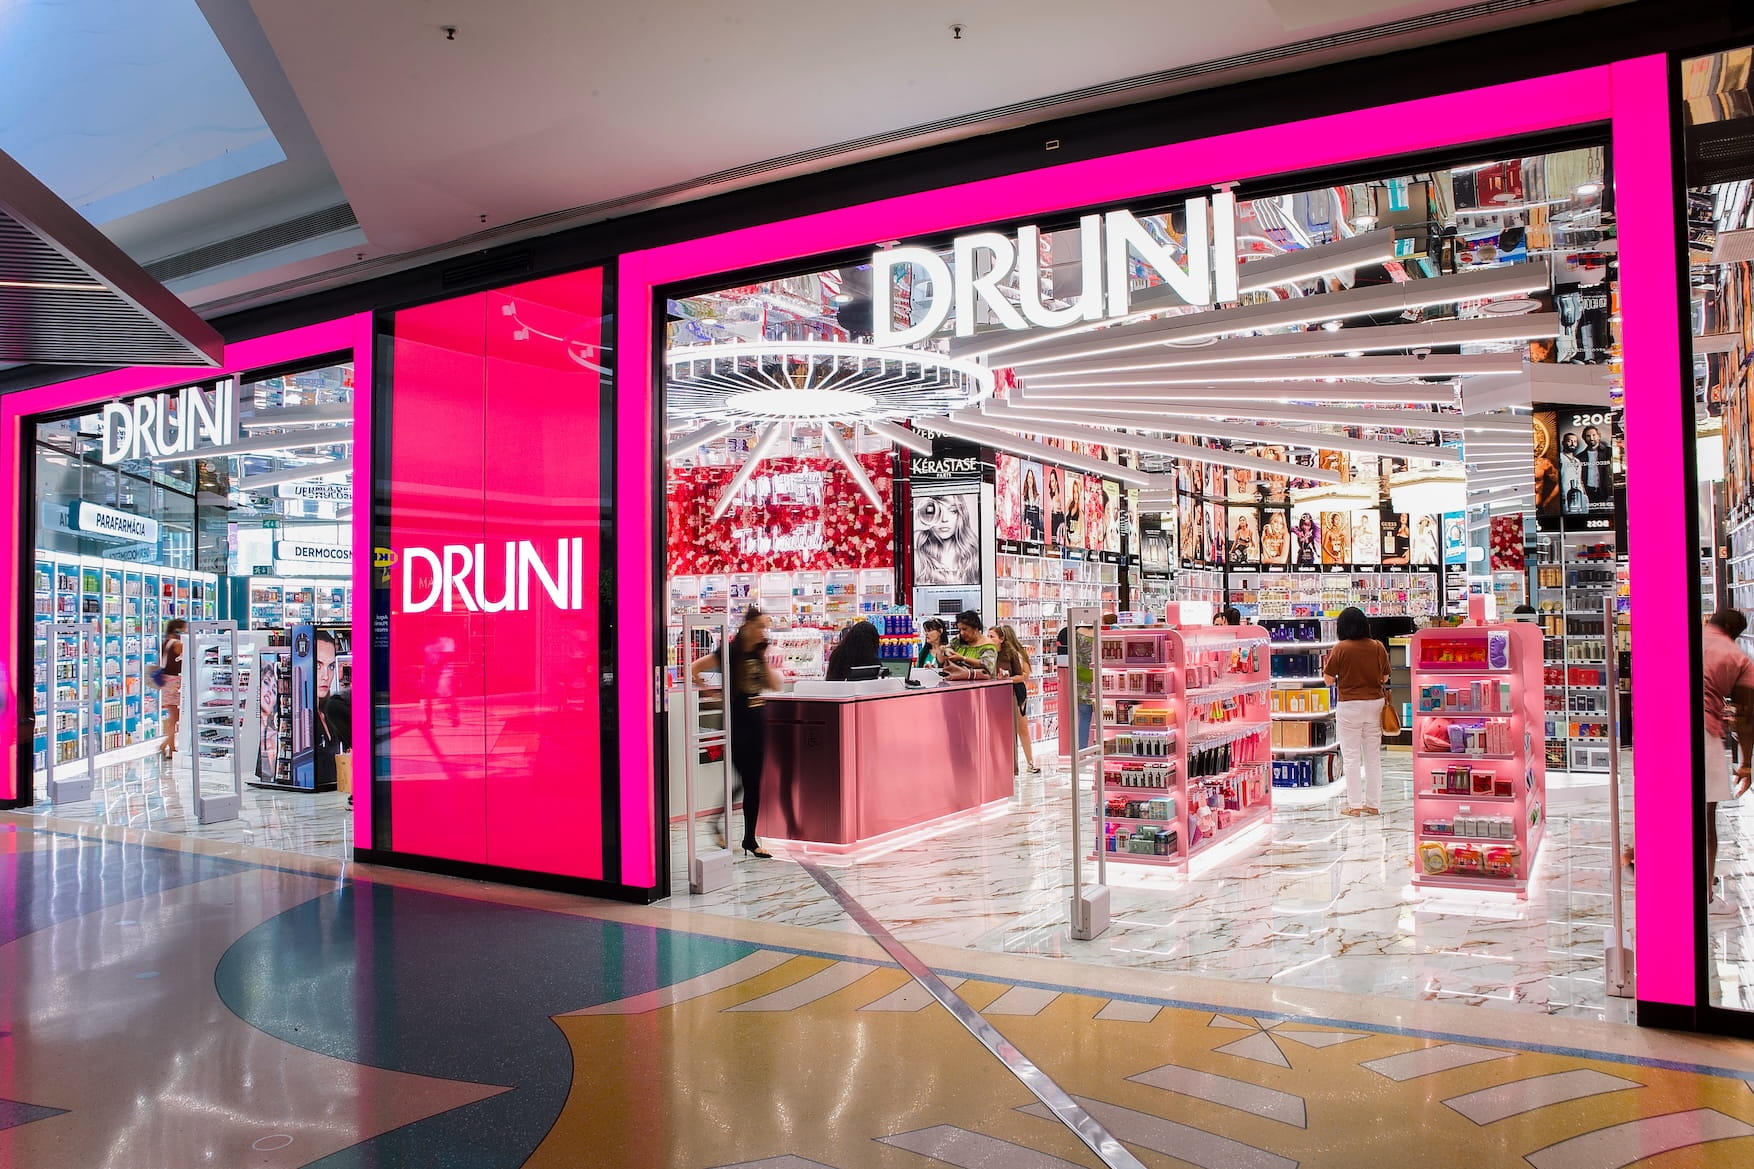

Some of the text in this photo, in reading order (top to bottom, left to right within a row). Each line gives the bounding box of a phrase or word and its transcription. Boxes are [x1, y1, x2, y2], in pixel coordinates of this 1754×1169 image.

[872, 191, 1239, 349] DRUNI
[102, 378, 234, 465] DRUNI
[912, 457, 977, 475] KÉRASTASE
[96, 512, 146, 537] PARAFARMÁCIA
[403, 537, 583, 613] DRUNI
